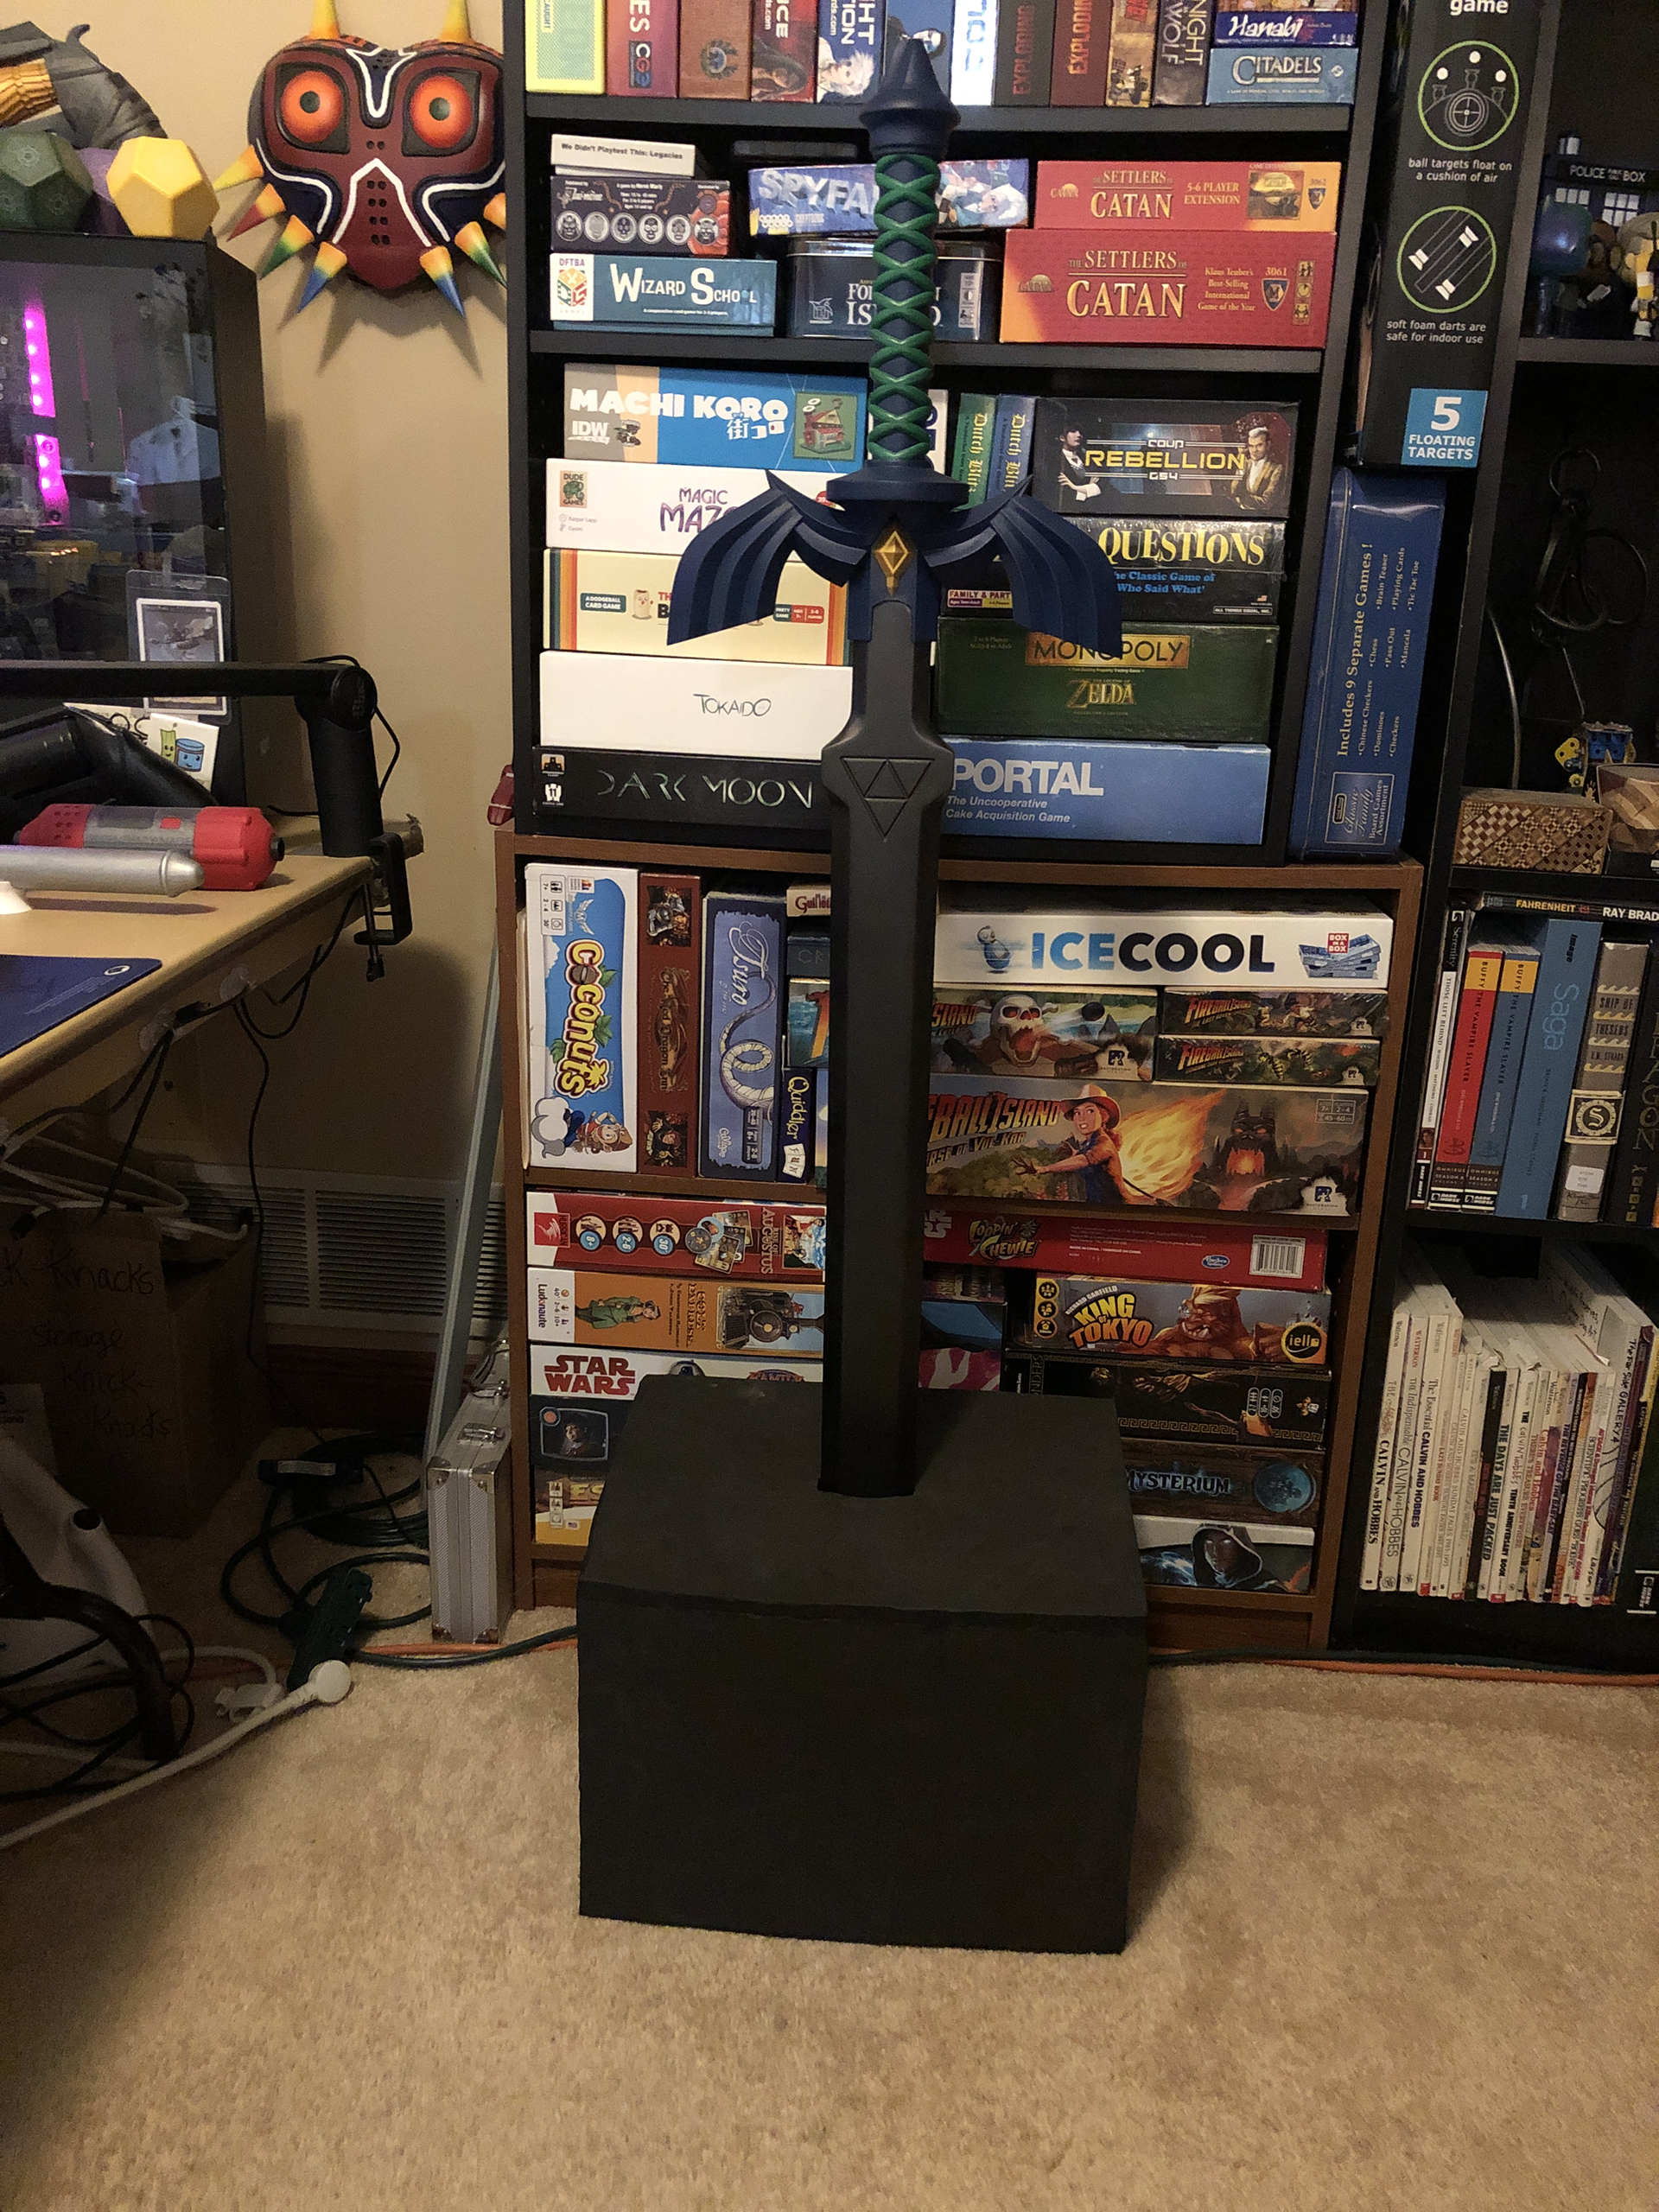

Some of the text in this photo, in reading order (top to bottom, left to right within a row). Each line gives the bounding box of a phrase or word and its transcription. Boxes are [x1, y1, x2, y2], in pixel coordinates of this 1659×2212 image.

[1450, 0, 1509, 16] game
[1229, 15, 1303, 37] Hanabi
[1232, 56, 1322, 85] CITADELS
[574, 143, 596, 152] Didn't
[597, 145, 627, 156] Playtest
[629, 148, 648, 156] This:
[649, 149, 683, 160] Legacies
[1408, 157, 1512, 171] ball targets float on
[1103, 170, 1166, 184] SETTLERS
[1187, 182, 1239, 193] 5-6 PLAYER
[1427, 171, 1467, 182] cushion
[1470, 173, 1483, 182] of
[1484, 173, 1498, 183] air
[1569, 165, 1605, 180] POLICE
[1623, 170, 1646, 183] BOX
[1090, 192, 1172, 219] CATAN
[1184, 194, 1240, 205] EXTENSION
[1205, 267, 1224, 276] Klaus
[1208, 279, 1249, 289] Best-Selling
[1265, 267, 1287, 276] 3061
[1066, 280, 1187, 318] CATAN
[1198, 302, 1256, 313] Game of the Year
[1205, 290, 1250, 300] International
[1386, 332, 1484, 344] safe for indoor use
[1387, 320, 1487, 333] soft foam darts are
[569, 387, 789, 423] MACHI KORO
[1430, 396, 1463, 431] 5
[571, 421, 610, 437] IDW
[968, 412, 988, 455] Dutch
[1408, 434, 1476, 447] FLOATING
[1084, 449, 1246, 470] REBELLION
[1408, 447, 1474, 461] TARGETS
[563, 473, 585, 481] DUDE
[679, 487, 728, 505] MAGIC
[1097, 526, 1265, 566] QUESTIONS
[1114, 571, 1217, 582] he Classic Game of
[1117, 583, 1142, 593] Who
[1144, 584, 1169, 594] Said
[1392, 547, 1406, 609] Playing Cards
[950, 590, 979, 599] FAMILY
[988, 591, 1012, 600] PART
[1346, 611, 1365, 676] Separate
[1369, 638, 1378, 664] Chess
[1401, 628, 1412, 664] Mancala
[1067, 679, 1136, 709] ZELDA
[1345, 680, 1356, 689] 9
[693, 693, 772, 717] TOKAIDO
[1358, 679, 1373, 753] Chinese Checkers
[1337, 693, 1355, 756] Includes
[1374, 711, 1385, 754] Dominoes
[1389, 715, 1401, 753] Checkers
[597, 769, 813, 809] DARK MOON
[951, 758, 1104, 796] PORTAL
[945, 809, 1071, 823] Cake Acquisition Game
[947, 795, 1048, 810] The Uncooperative
[1376, 785, 1390, 837] Assortment
[1516, 899, 1576, 913] FAHRENHEIT
[1603, 907, 1626, 919] RAY
[1032, 931, 1275, 974] ICECOOL
[1448, 926, 1463, 968] Serenity
[728, 921, 767, 1007] Tsuro
[1441, 1003, 1450, 1020] LEFT
[1599, 997, 1634, 1009] SHIP OF
[1462, 961, 1488, 1082] BUFFY THE VAMPIRE SLAYER
[1497, 963, 1524, 1084] BUFFY THE VAMPIRE SLAYER
[1542, 983, 1580, 1051] Saga
[1438, 1020, 1448, 1046] BEHIND
[786, 1077, 810, 1140] Quiddler
[760, 1207, 773, 1274] AUGUSTUS
[980, 1234, 1036, 1261] CHEWIE
[537, 1283, 548, 1328] Ludonaute
[1065, 1285, 1118, 1315] RICHARD GARFIELD
[1074, 1293, 1136, 1325] KING
[1069, 1318, 1154, 1348] TOKYO
[544, 1355, 636, 1376] STAR
[545, 1373, 636, 1395] WARS
[1402, 1391, 1418, 1446] Indispensable
[1423, 1396, 1437, 1431] Essential
[1418, 1431, 1431, 1465] CALVIN
[1376, 1440, 1390, 1486] CALVIN
[1394, 1446, 1411, 1496] CALVIN
[1126, 1469, 1230, 1497] MYSTERIUM
[1414, 1468, 1427, 1489] AND
[1481, 1424, 1510, 1560] THE DAYS ARE JUST PACKED
[1368, 1500, 1382, 1545] HOBBES
[1411, 1489, 1423, 1529] HOBBES
[1386, 1508, 1404, 1558] HOBBES
